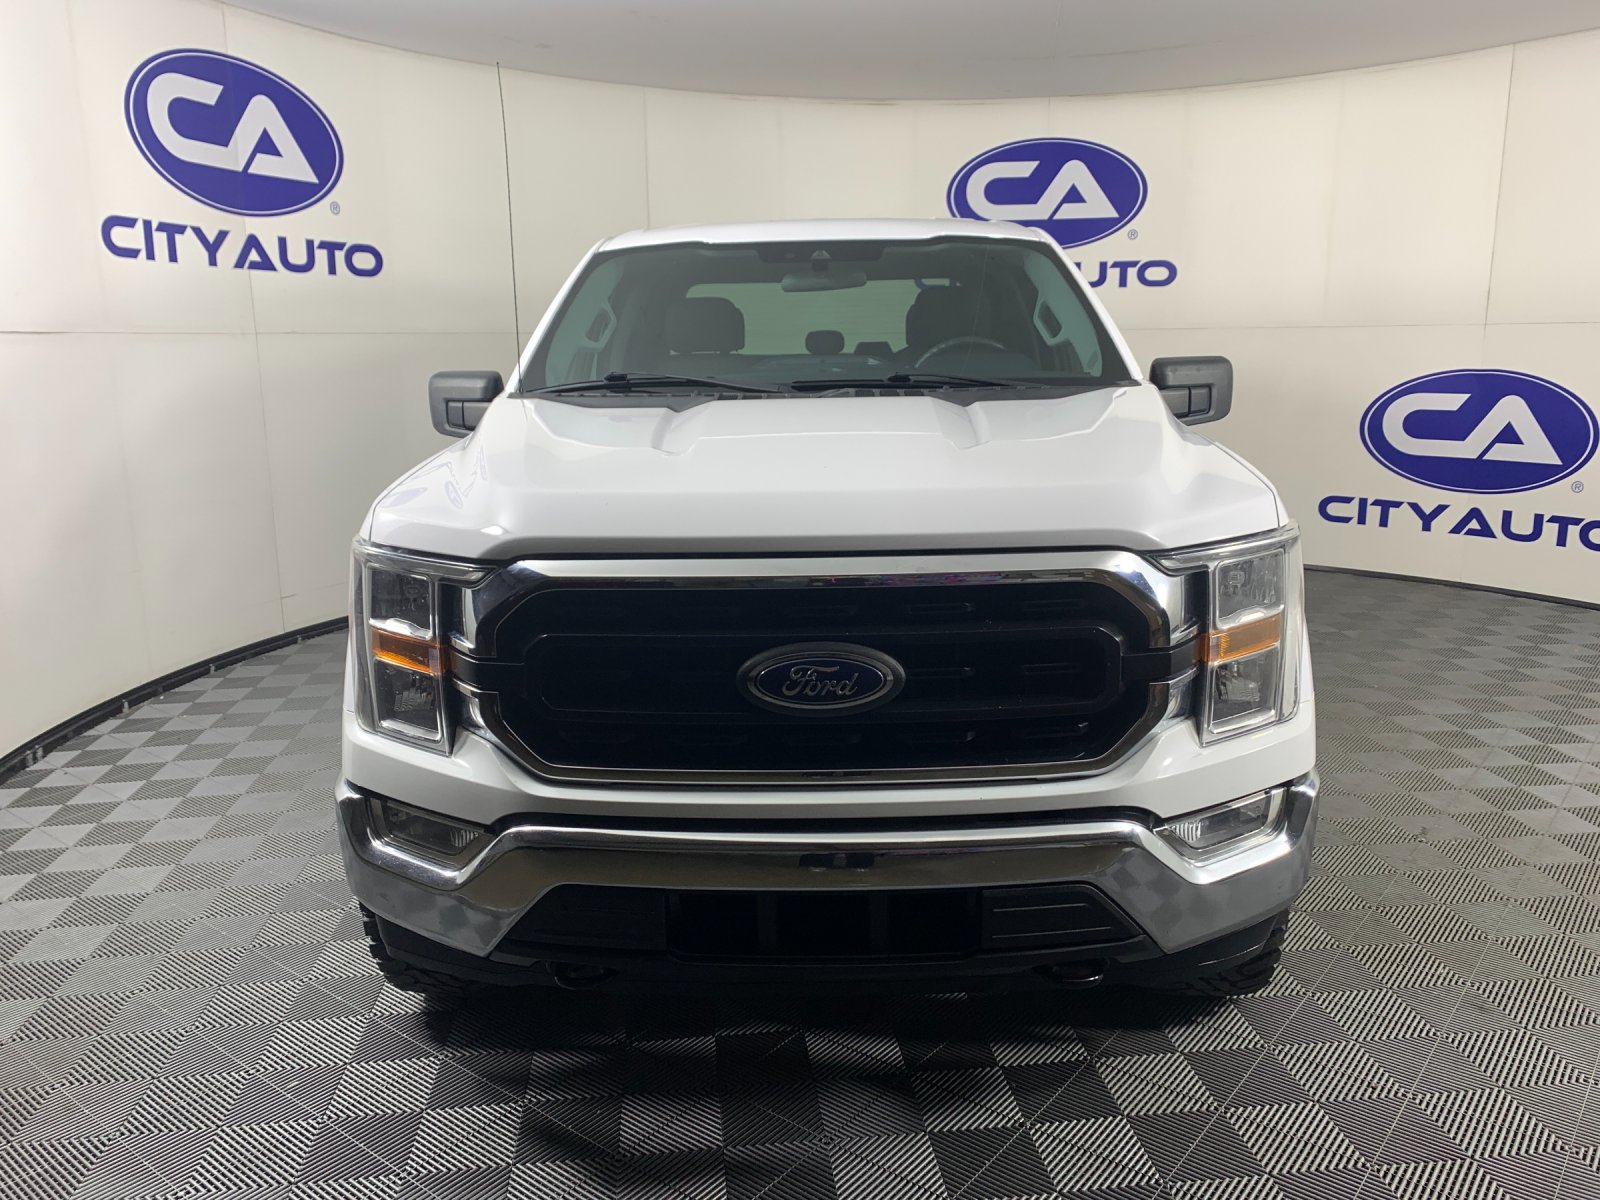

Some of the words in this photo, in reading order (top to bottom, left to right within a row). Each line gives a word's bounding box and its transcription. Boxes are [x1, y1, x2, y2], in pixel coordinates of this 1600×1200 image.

[147, 72, 320, 184] CA
[966, 159, 1120, 221] CA
[101, 214, 231, 267] CITY
[233, 233, 384, 277] AUTO
[1073, 259, 1178, 288] UTO
[1382, 392, 1563, 466] CA
[1318, 495, 1451, 533] CITY
[781, 664, 860, 697] Ford
